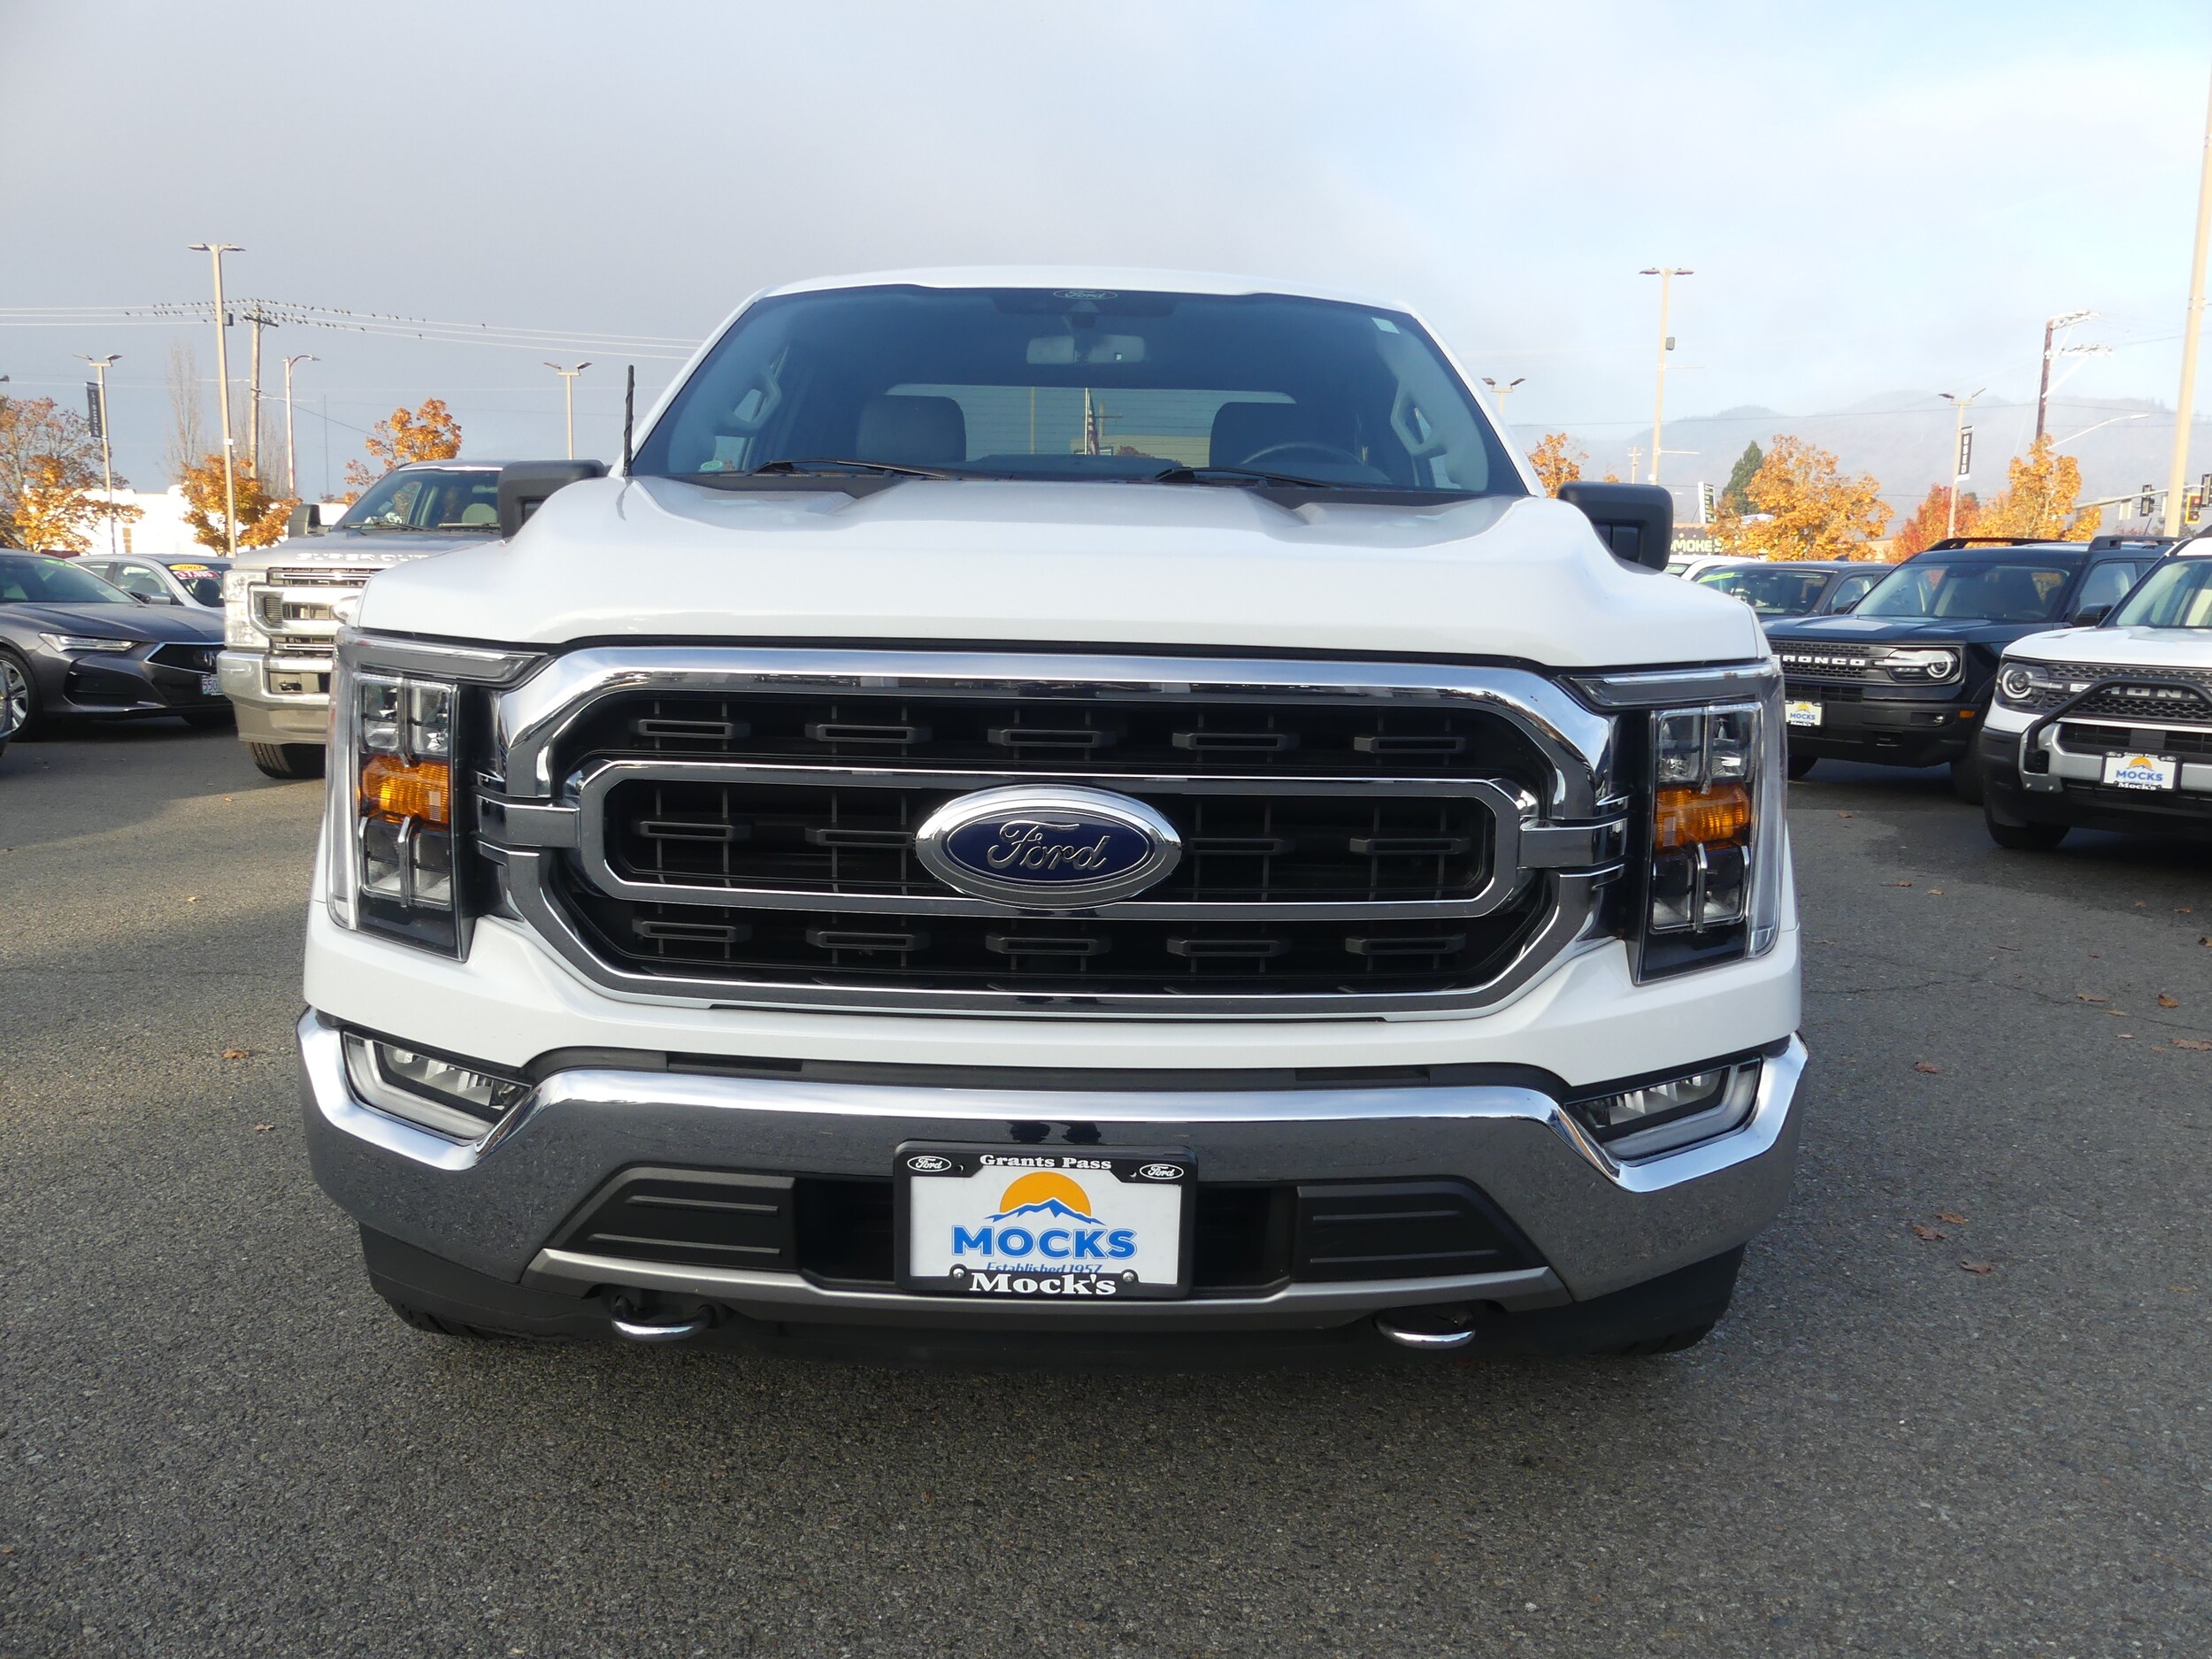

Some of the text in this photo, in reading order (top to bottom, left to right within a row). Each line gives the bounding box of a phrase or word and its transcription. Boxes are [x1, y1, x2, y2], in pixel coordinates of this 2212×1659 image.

[1961, 434, 1970, 474] USED
[1670, 539, 1713, 553] MOKE
[380, 553, 430, 563] DUT
[1782, 655, 1866, 666] RONCO
[2116, 769, 2163, 782] MOCKS
[2117, 782, 2157, 791] Mock's
[987, 819, 1111, 871] Ford
[915, 1157, 943, 1170] Ford
[979, 1154, 1112, 1170] Grants Pass
[1147, 1165, 1176, 1178] Ford
[951, 1225, 1138, 1260] MOCKS
[987, 1262, 1103, 1274] Established 1957
[969, 1272, 1117, 1295] Mock's
